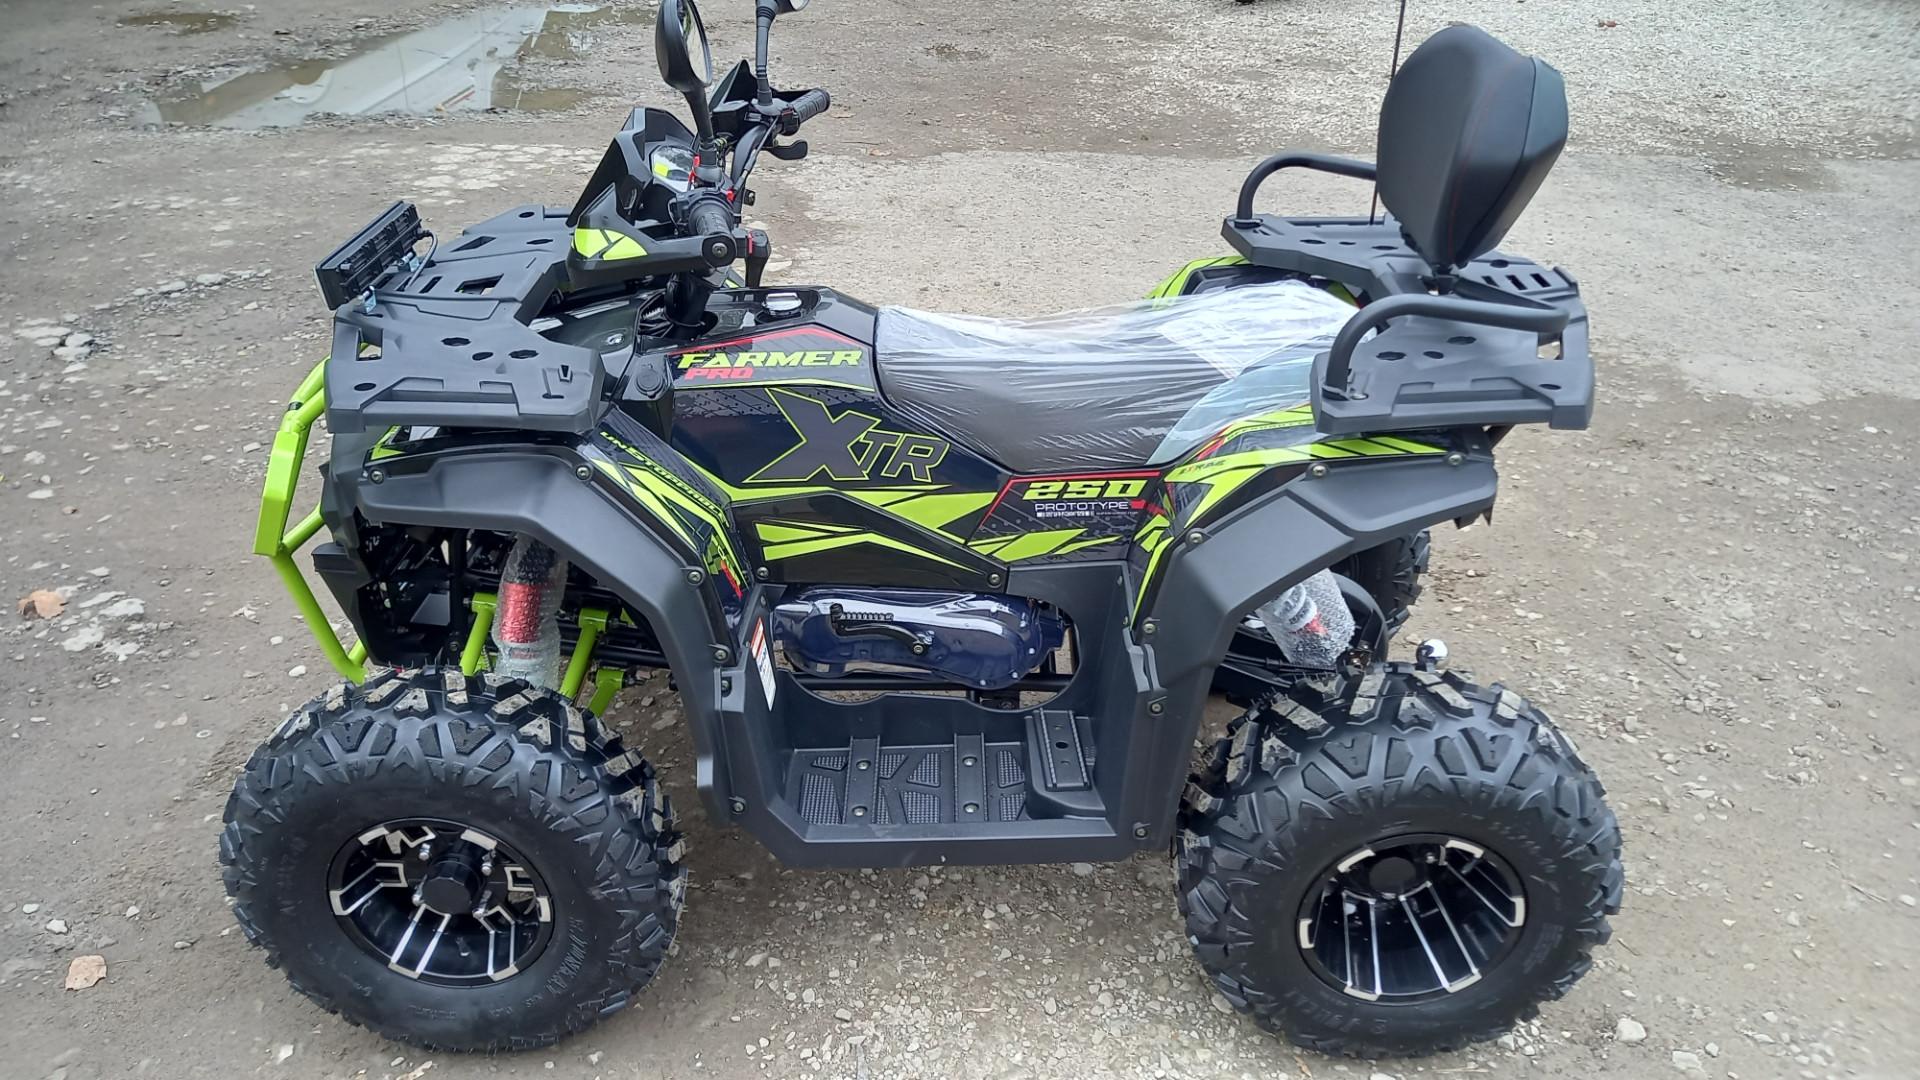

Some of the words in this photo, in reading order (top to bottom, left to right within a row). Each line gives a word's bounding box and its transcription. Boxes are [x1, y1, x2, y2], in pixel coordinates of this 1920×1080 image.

[677, 350, 863, 369] FARMER
[684, 367, 754, 380] PRO
[741, 387, 950, 484] XTR
[1022, 479, 1149, 500] 250
[1034, 501, 1130, 512] PROTOTYPE
